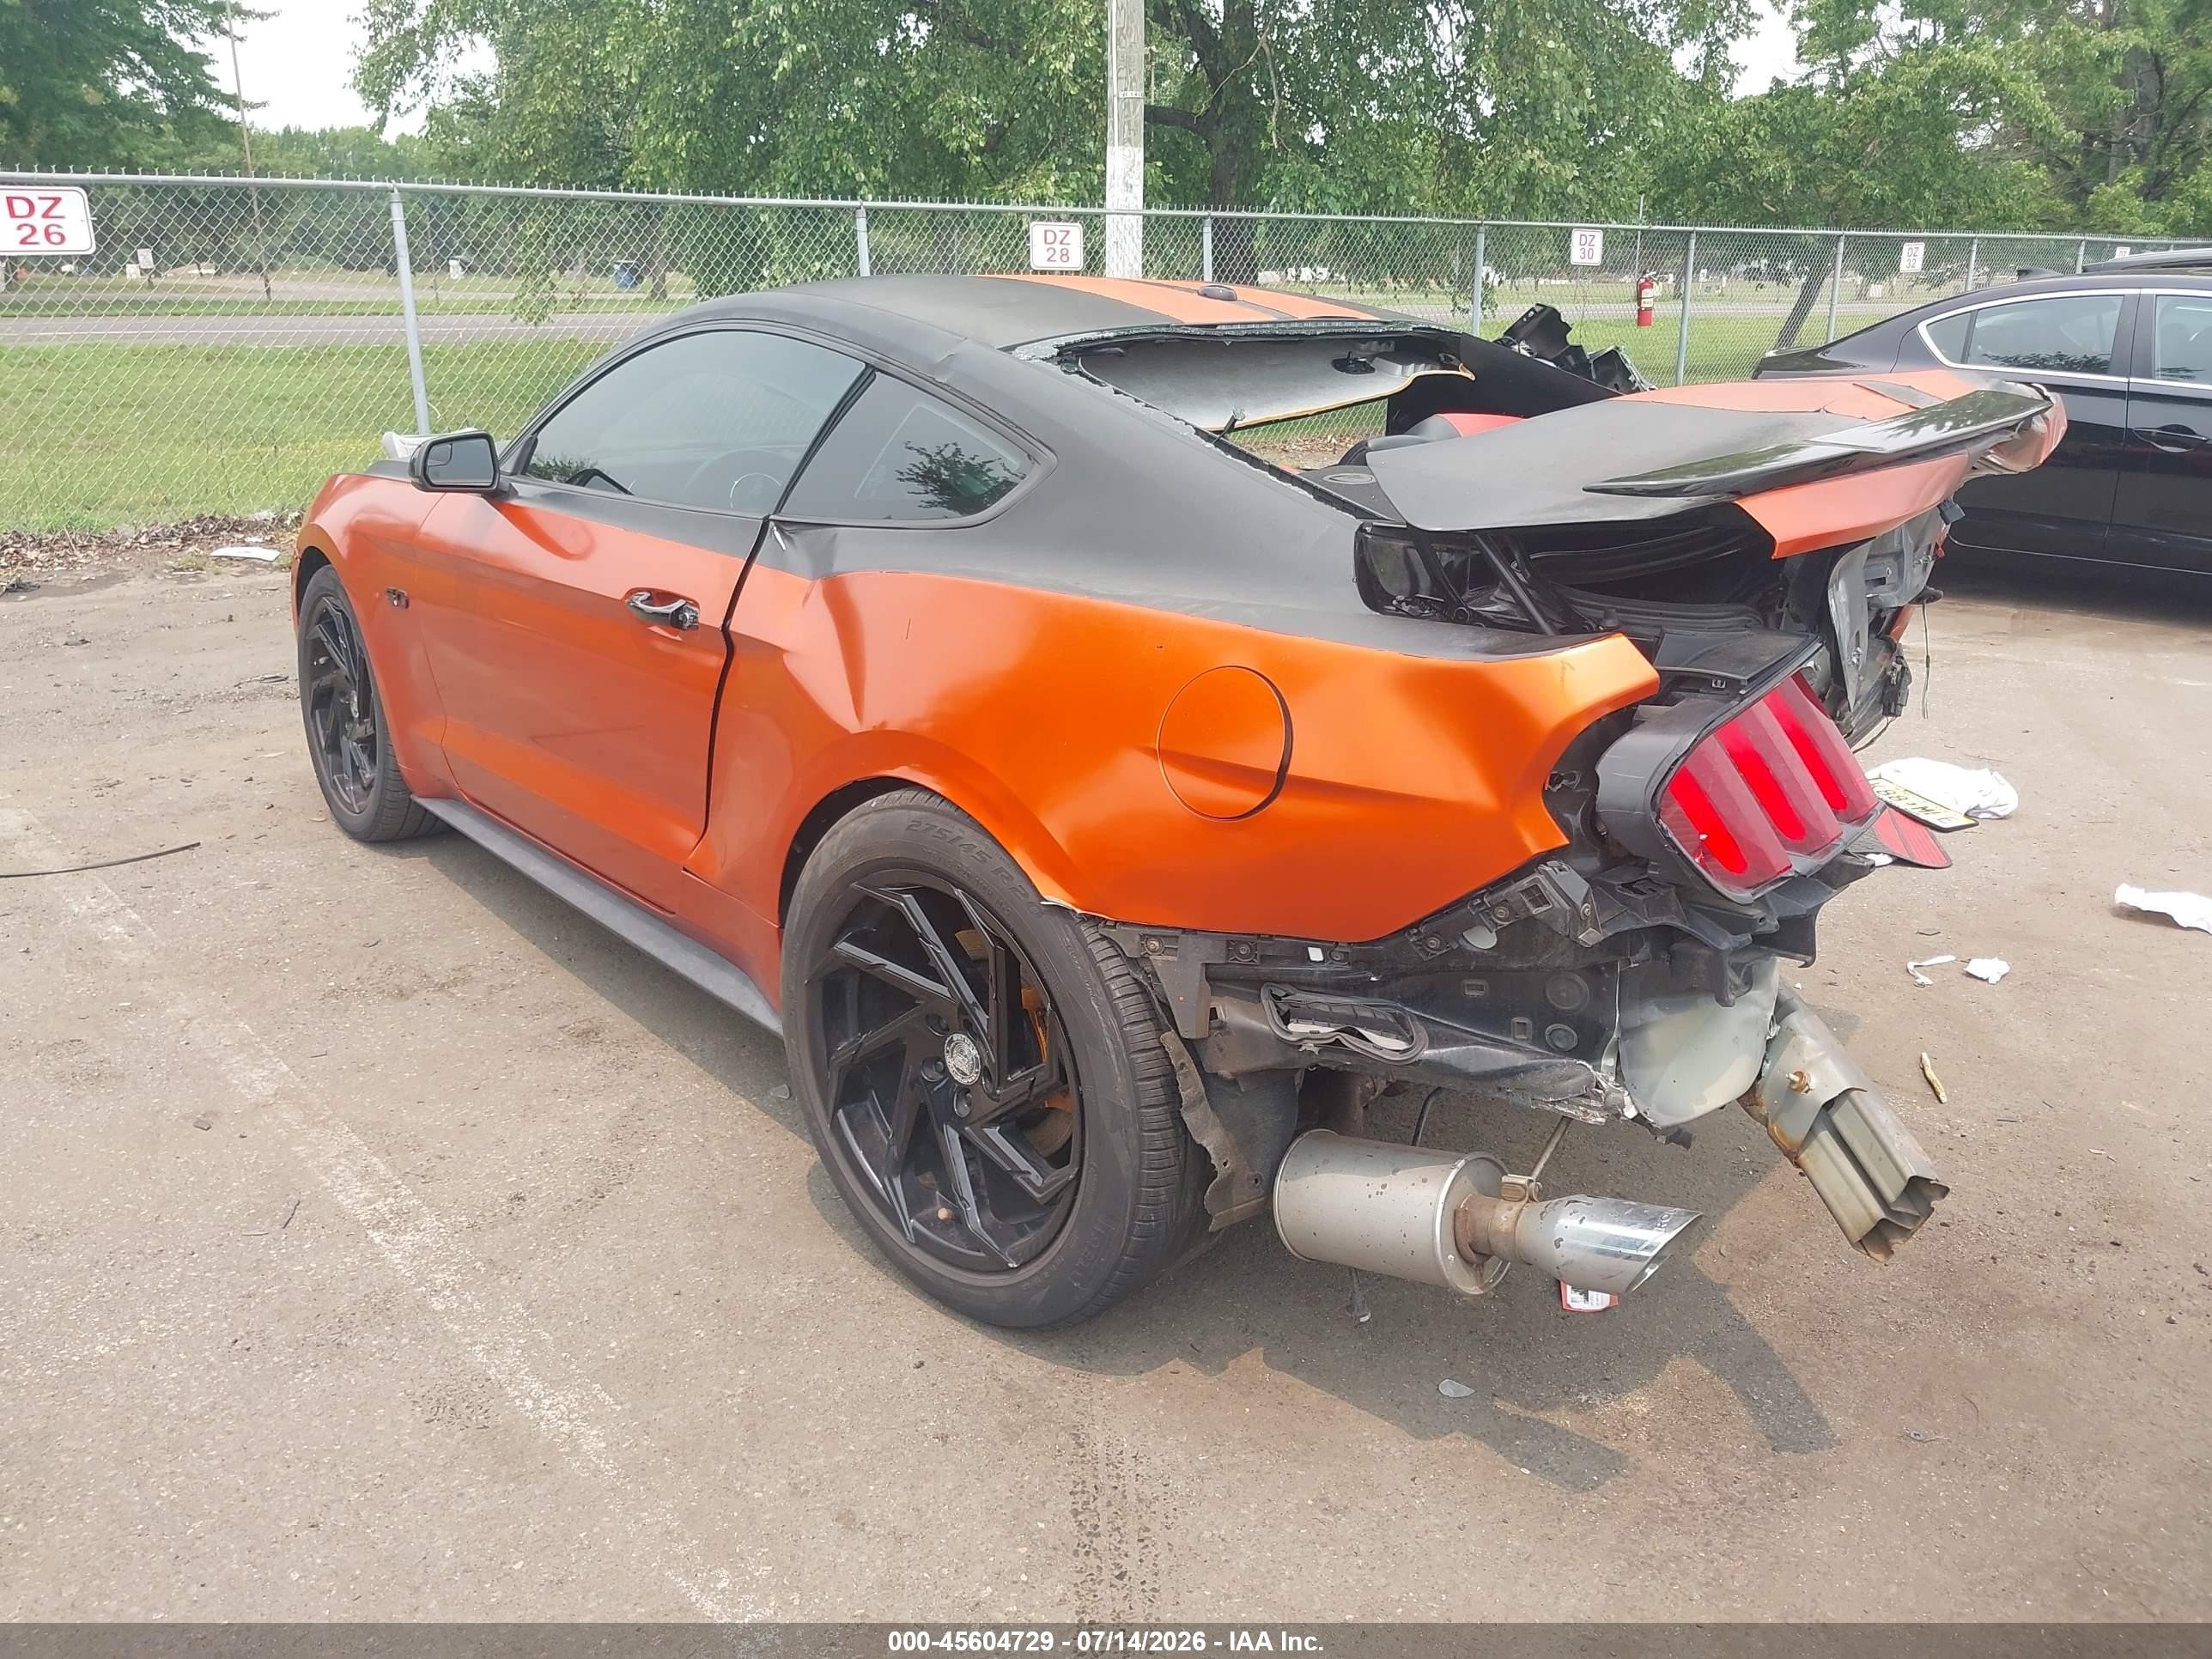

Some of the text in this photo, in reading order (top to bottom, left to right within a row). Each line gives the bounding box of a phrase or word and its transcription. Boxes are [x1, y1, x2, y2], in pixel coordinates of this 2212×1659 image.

[5, 196, 66, 219] DZ
[15, 223, 67, 246] 26
[1043, 229, 1072, 246] DZ
[1579, 234, 1595, 246] DZ
[1046, 247, 1070, 263] 28
[1579, 247, 1594, 260] 30
[1906, 246, 1920, 258] DZ
[1905, 258, 1917, 269] 32
[905, 819, 994, 866] 275/45
